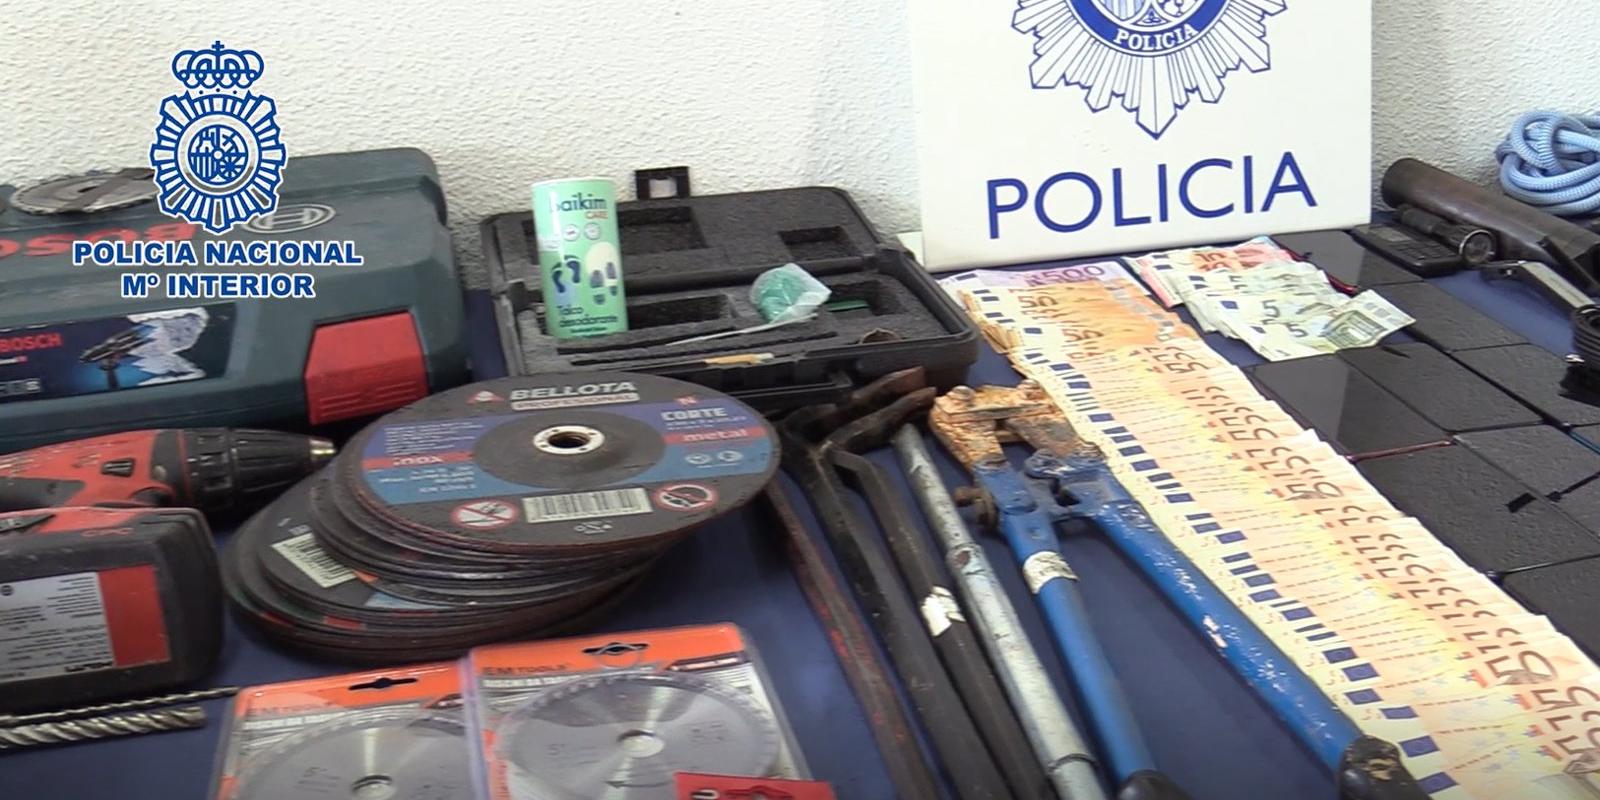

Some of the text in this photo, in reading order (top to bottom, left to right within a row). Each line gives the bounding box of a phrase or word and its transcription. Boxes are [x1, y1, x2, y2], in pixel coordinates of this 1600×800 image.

[1114, 24, 1198, 50] POLICIA
[987, 152, 1318, 239] POLICIA
[1039, 265, 1106, 281] 500
[1262, 299, 1281, 318] 5
[1286, 322, 1308, 338] 5
[511, 382, 637, 401] BELLOTA
[660, 407, 728, 421] CORTE
[682, 429, 749, 442] metal
[1285, 481, 1345, 498] 50
[1484, 650, 1559, 682] 50
